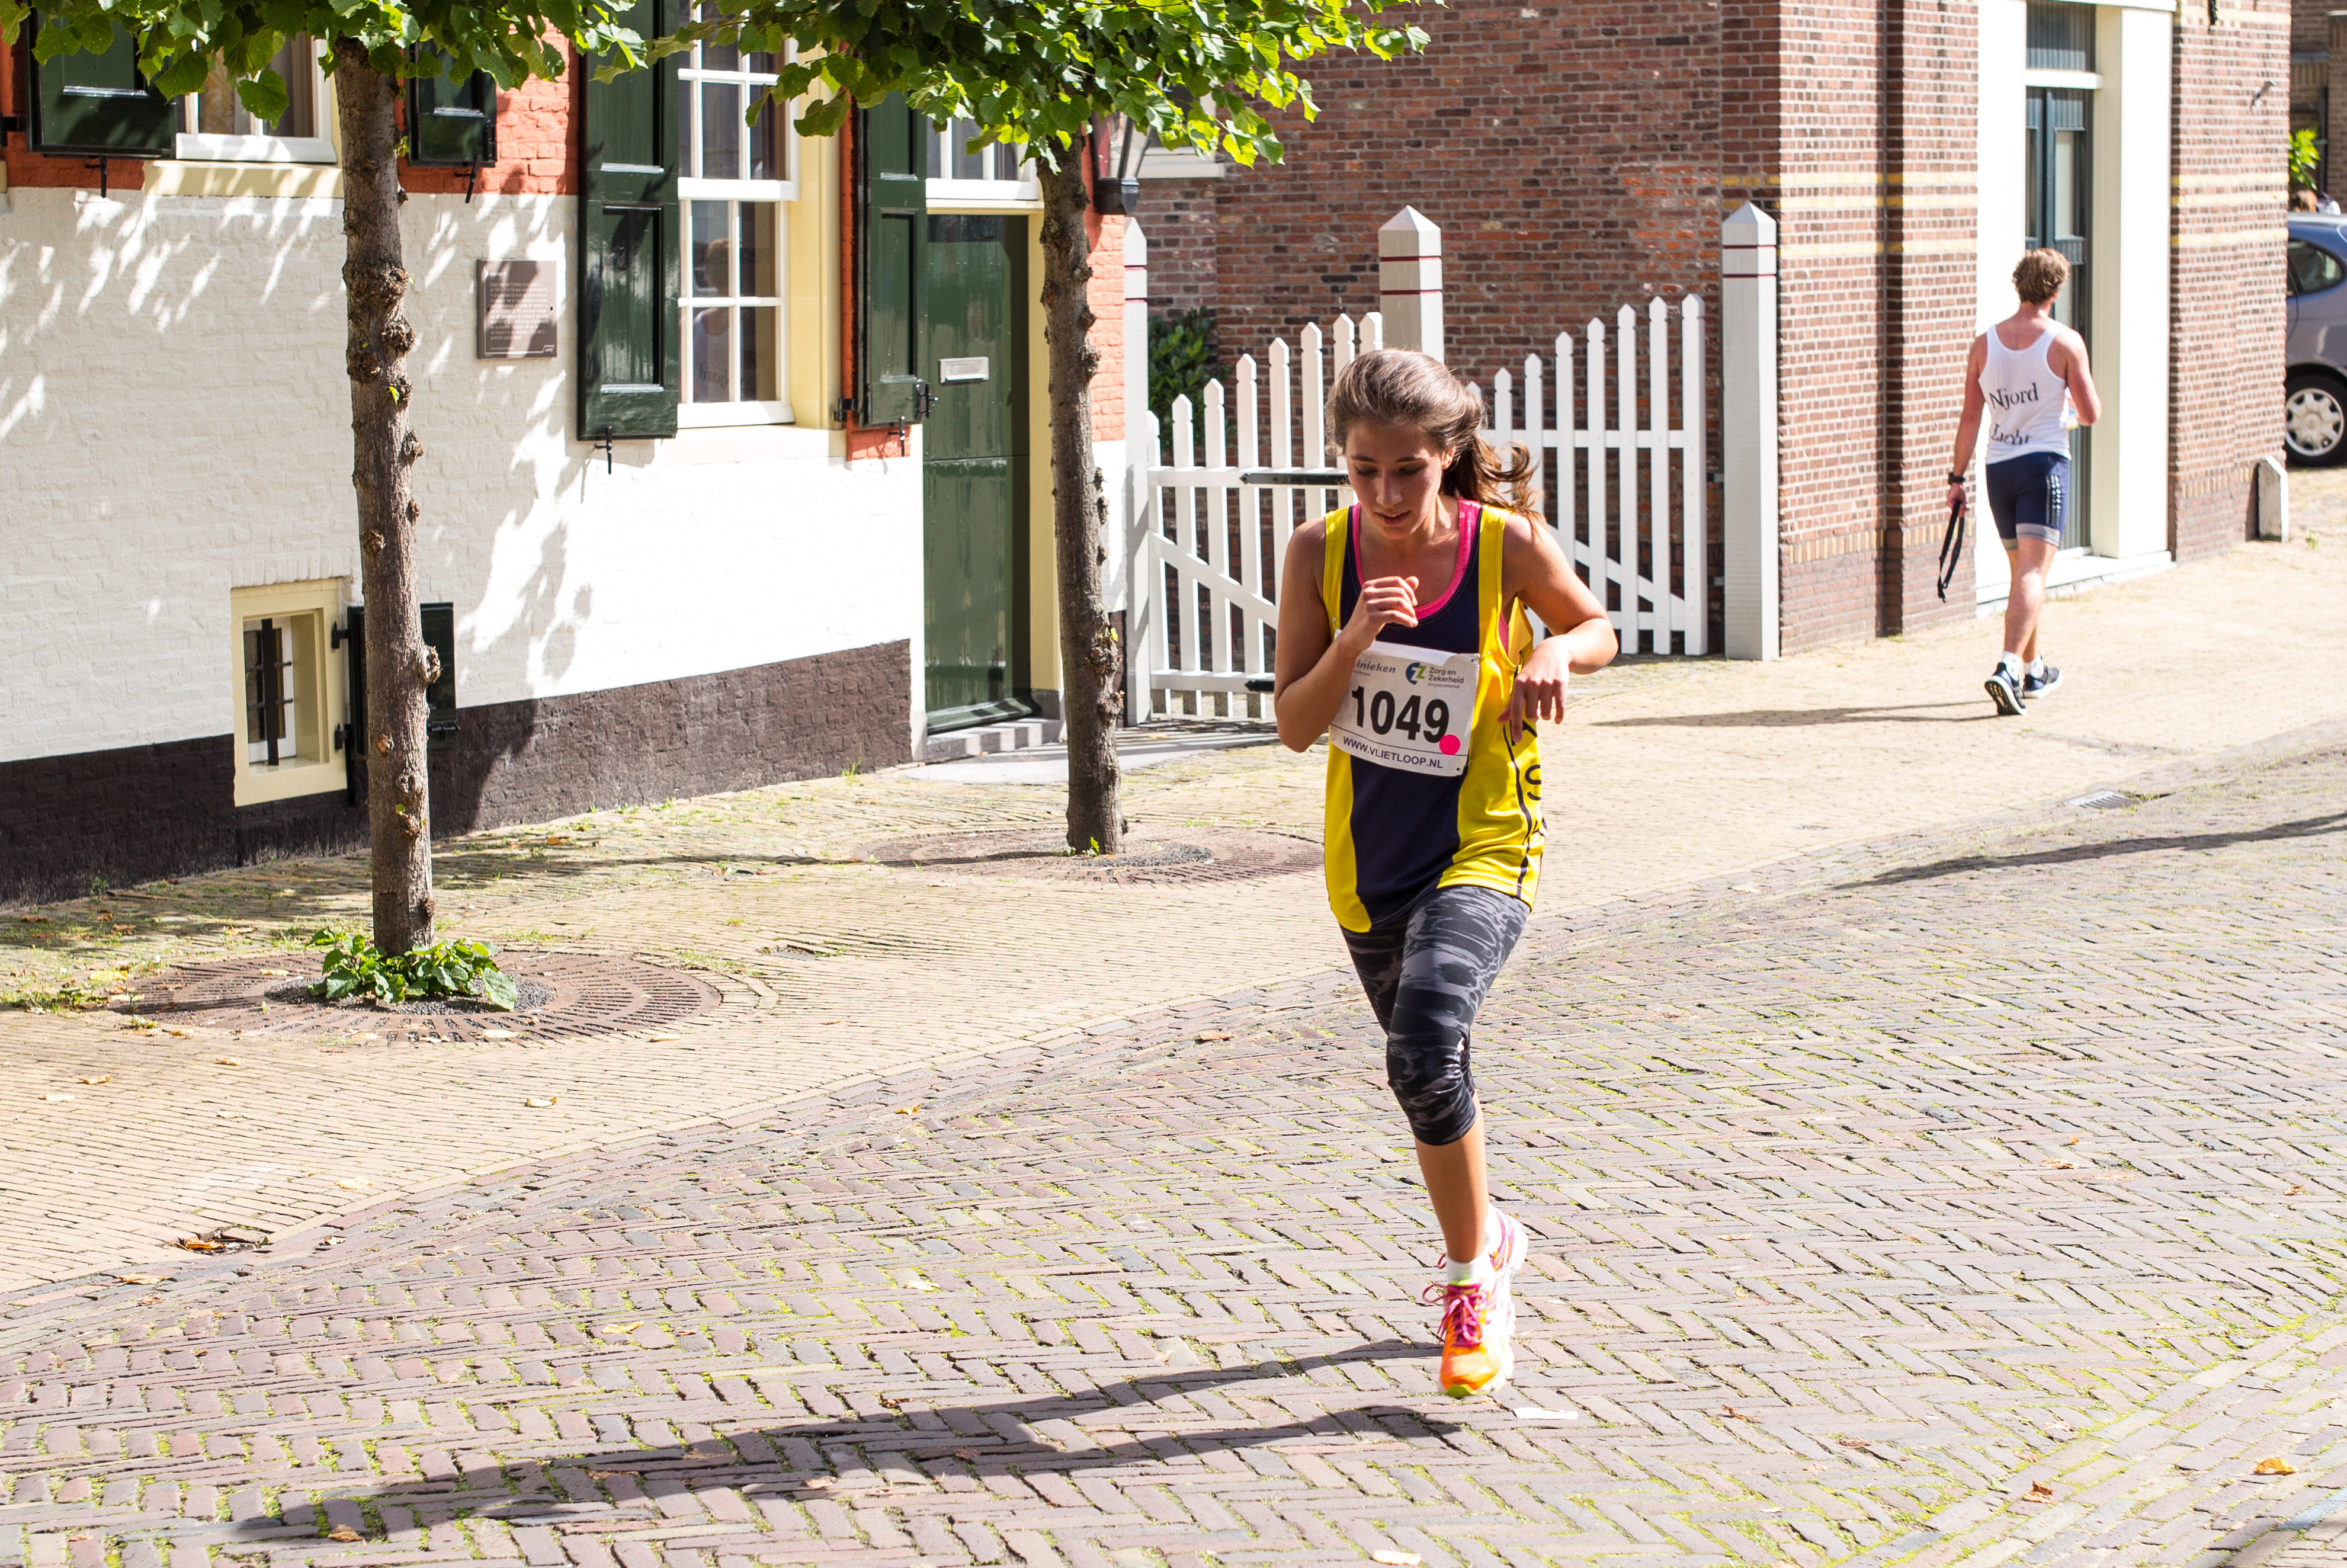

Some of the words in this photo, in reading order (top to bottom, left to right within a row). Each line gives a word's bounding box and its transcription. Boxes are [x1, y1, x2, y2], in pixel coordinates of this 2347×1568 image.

[1989, 381, 2039, 410] Njord
[1356, 659, 1396, 674] inieken
[1429, 667, 1445, 675] Zorg
[1428, 675, 1464, 684] Zekerheid
[1352, 685, 1450, 743] 1049
[1343, 736, 1443, 768] WWW.VLIETLOOP.NL
